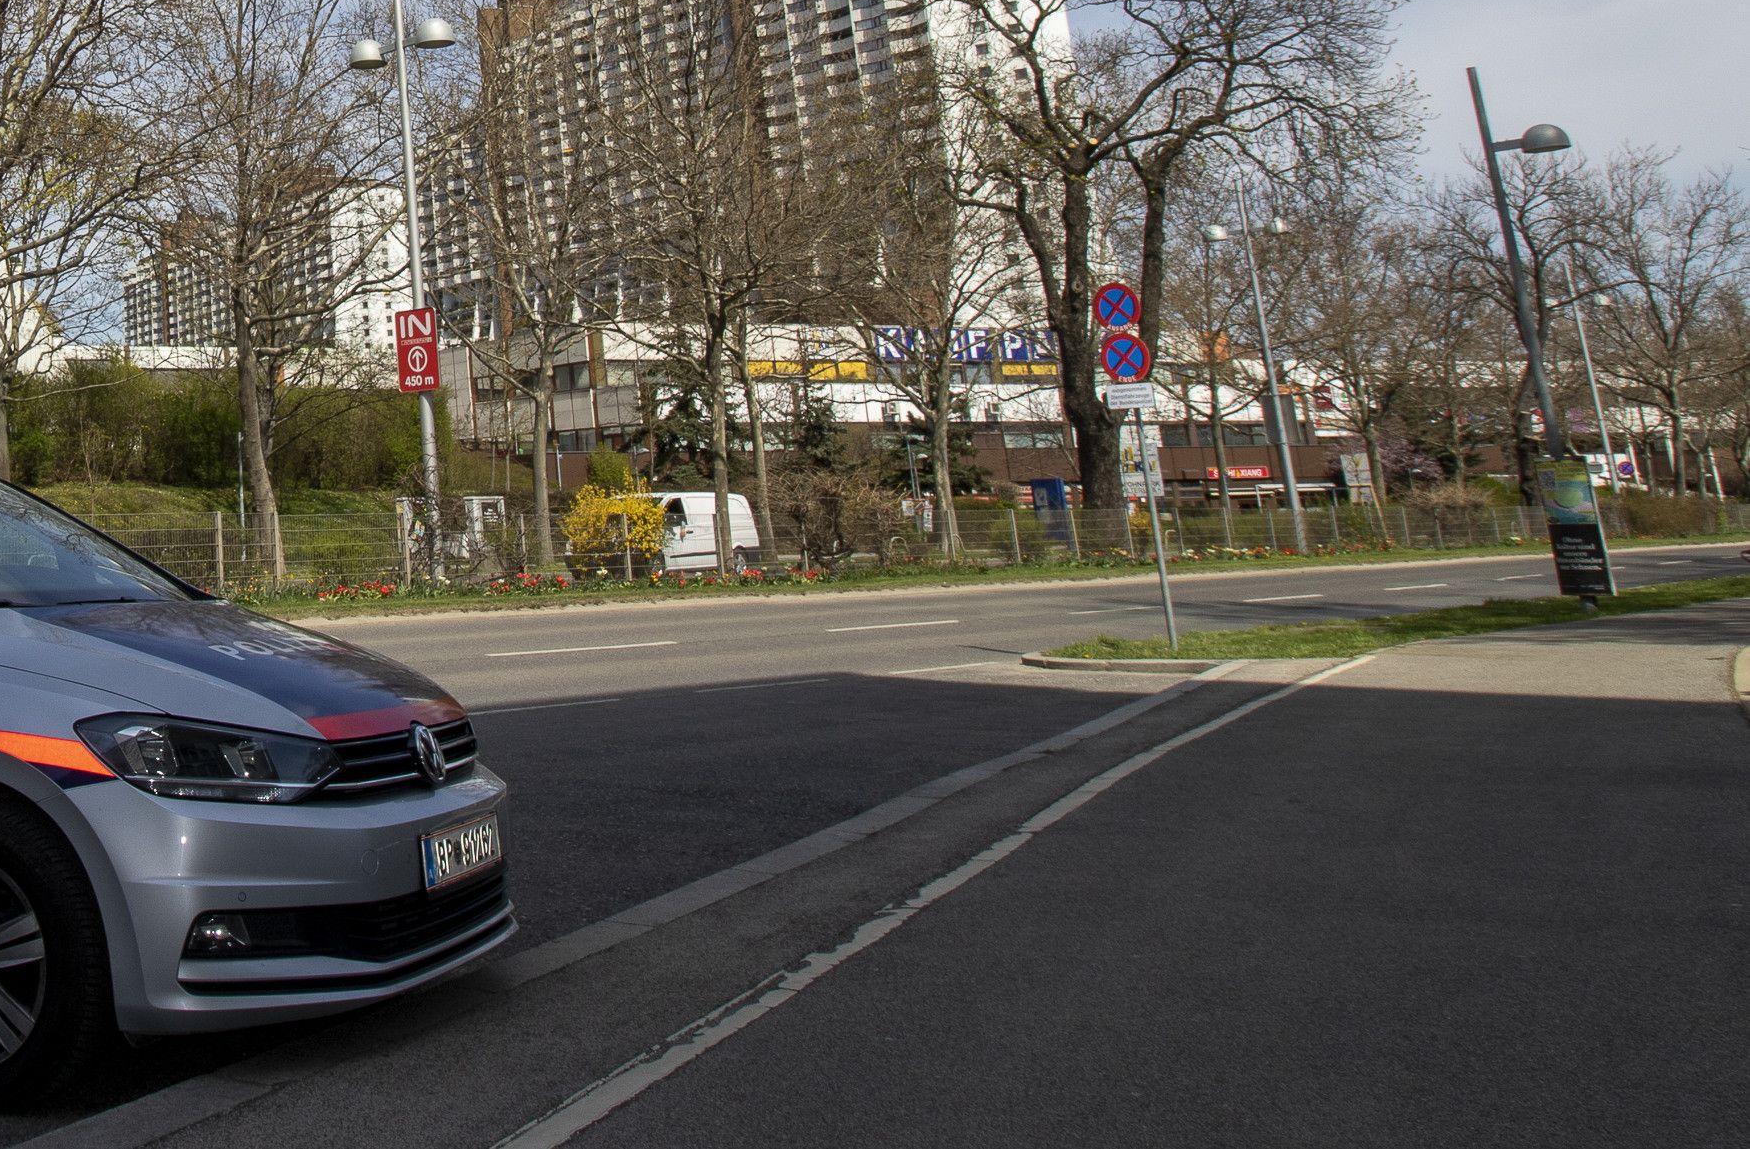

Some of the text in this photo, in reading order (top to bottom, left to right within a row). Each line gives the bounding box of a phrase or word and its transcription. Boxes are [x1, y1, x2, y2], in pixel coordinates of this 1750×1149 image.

[400, 312, 431, 338] IN
[405, 375, 434, 387] 450 m
[1118, 375, 1137, 383] ENDE
[1240, 468, 1262, 477] XIANG
[435, 838, 452, 877] BP
